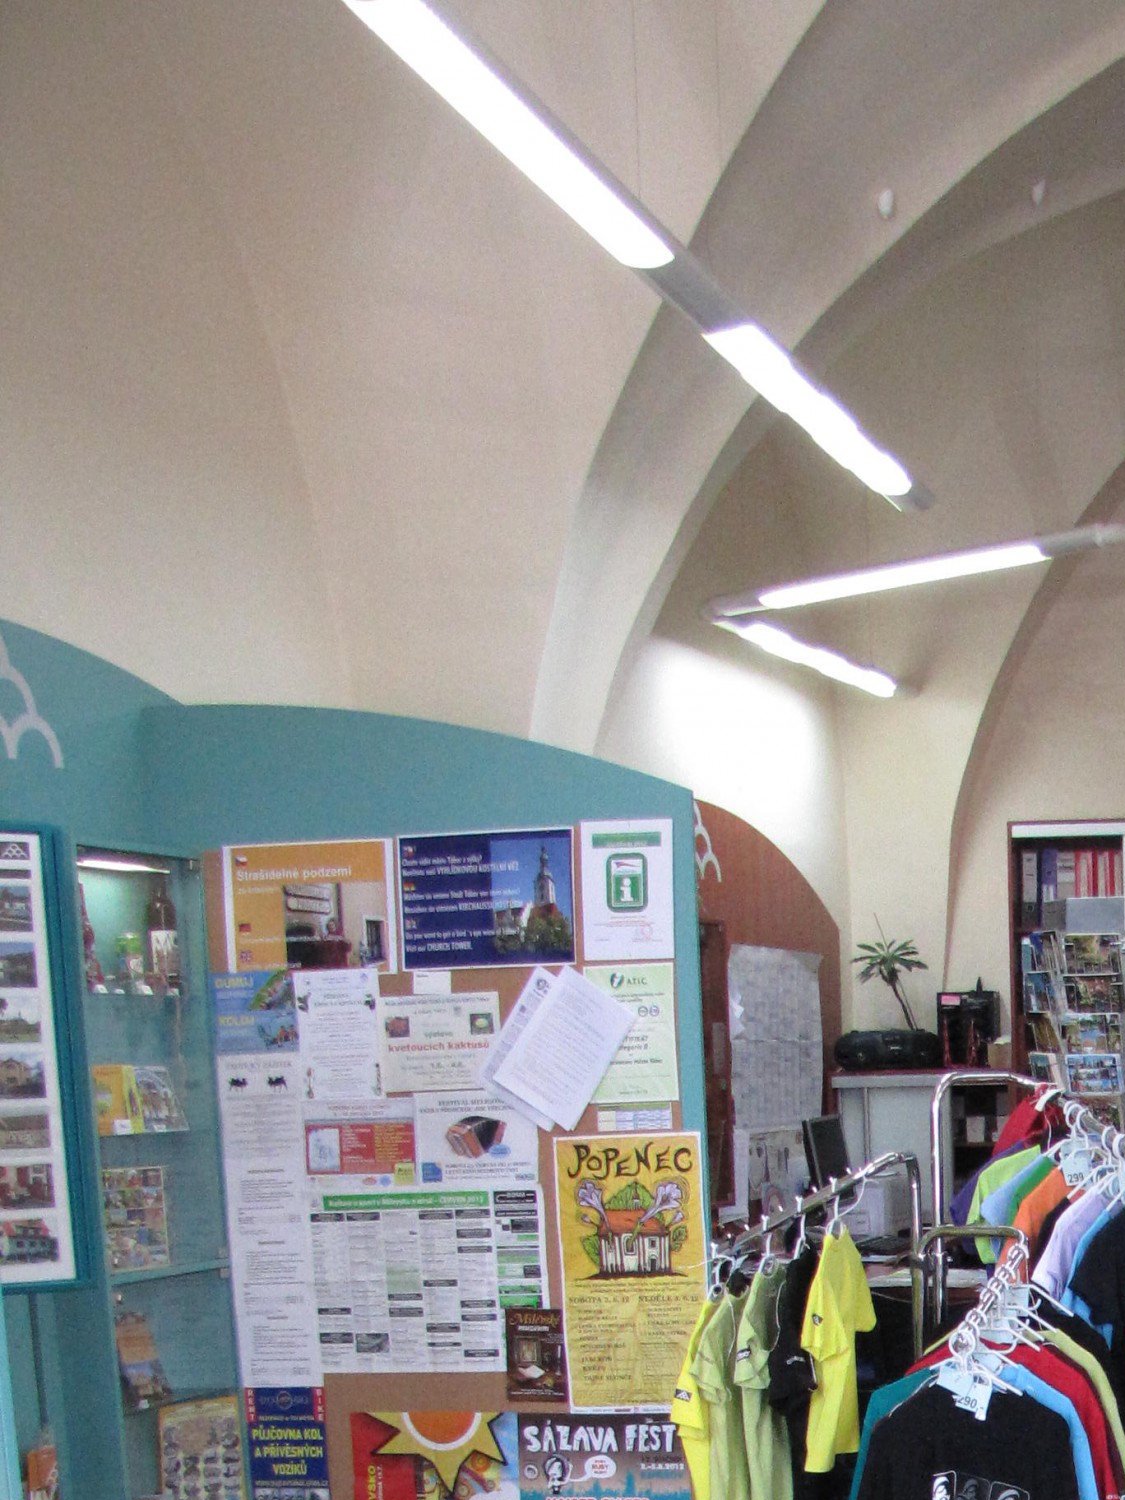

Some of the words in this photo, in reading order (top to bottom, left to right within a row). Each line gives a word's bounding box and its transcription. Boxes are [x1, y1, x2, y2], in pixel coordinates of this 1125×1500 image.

[567, 1141, 693, 1180] POPENEC
[252, 1424, 303, 1440] PŮJČOVNA
[304, 1428, 324, 1440] KOL
[523, 1420, 618, 1452] SÁZAVA
